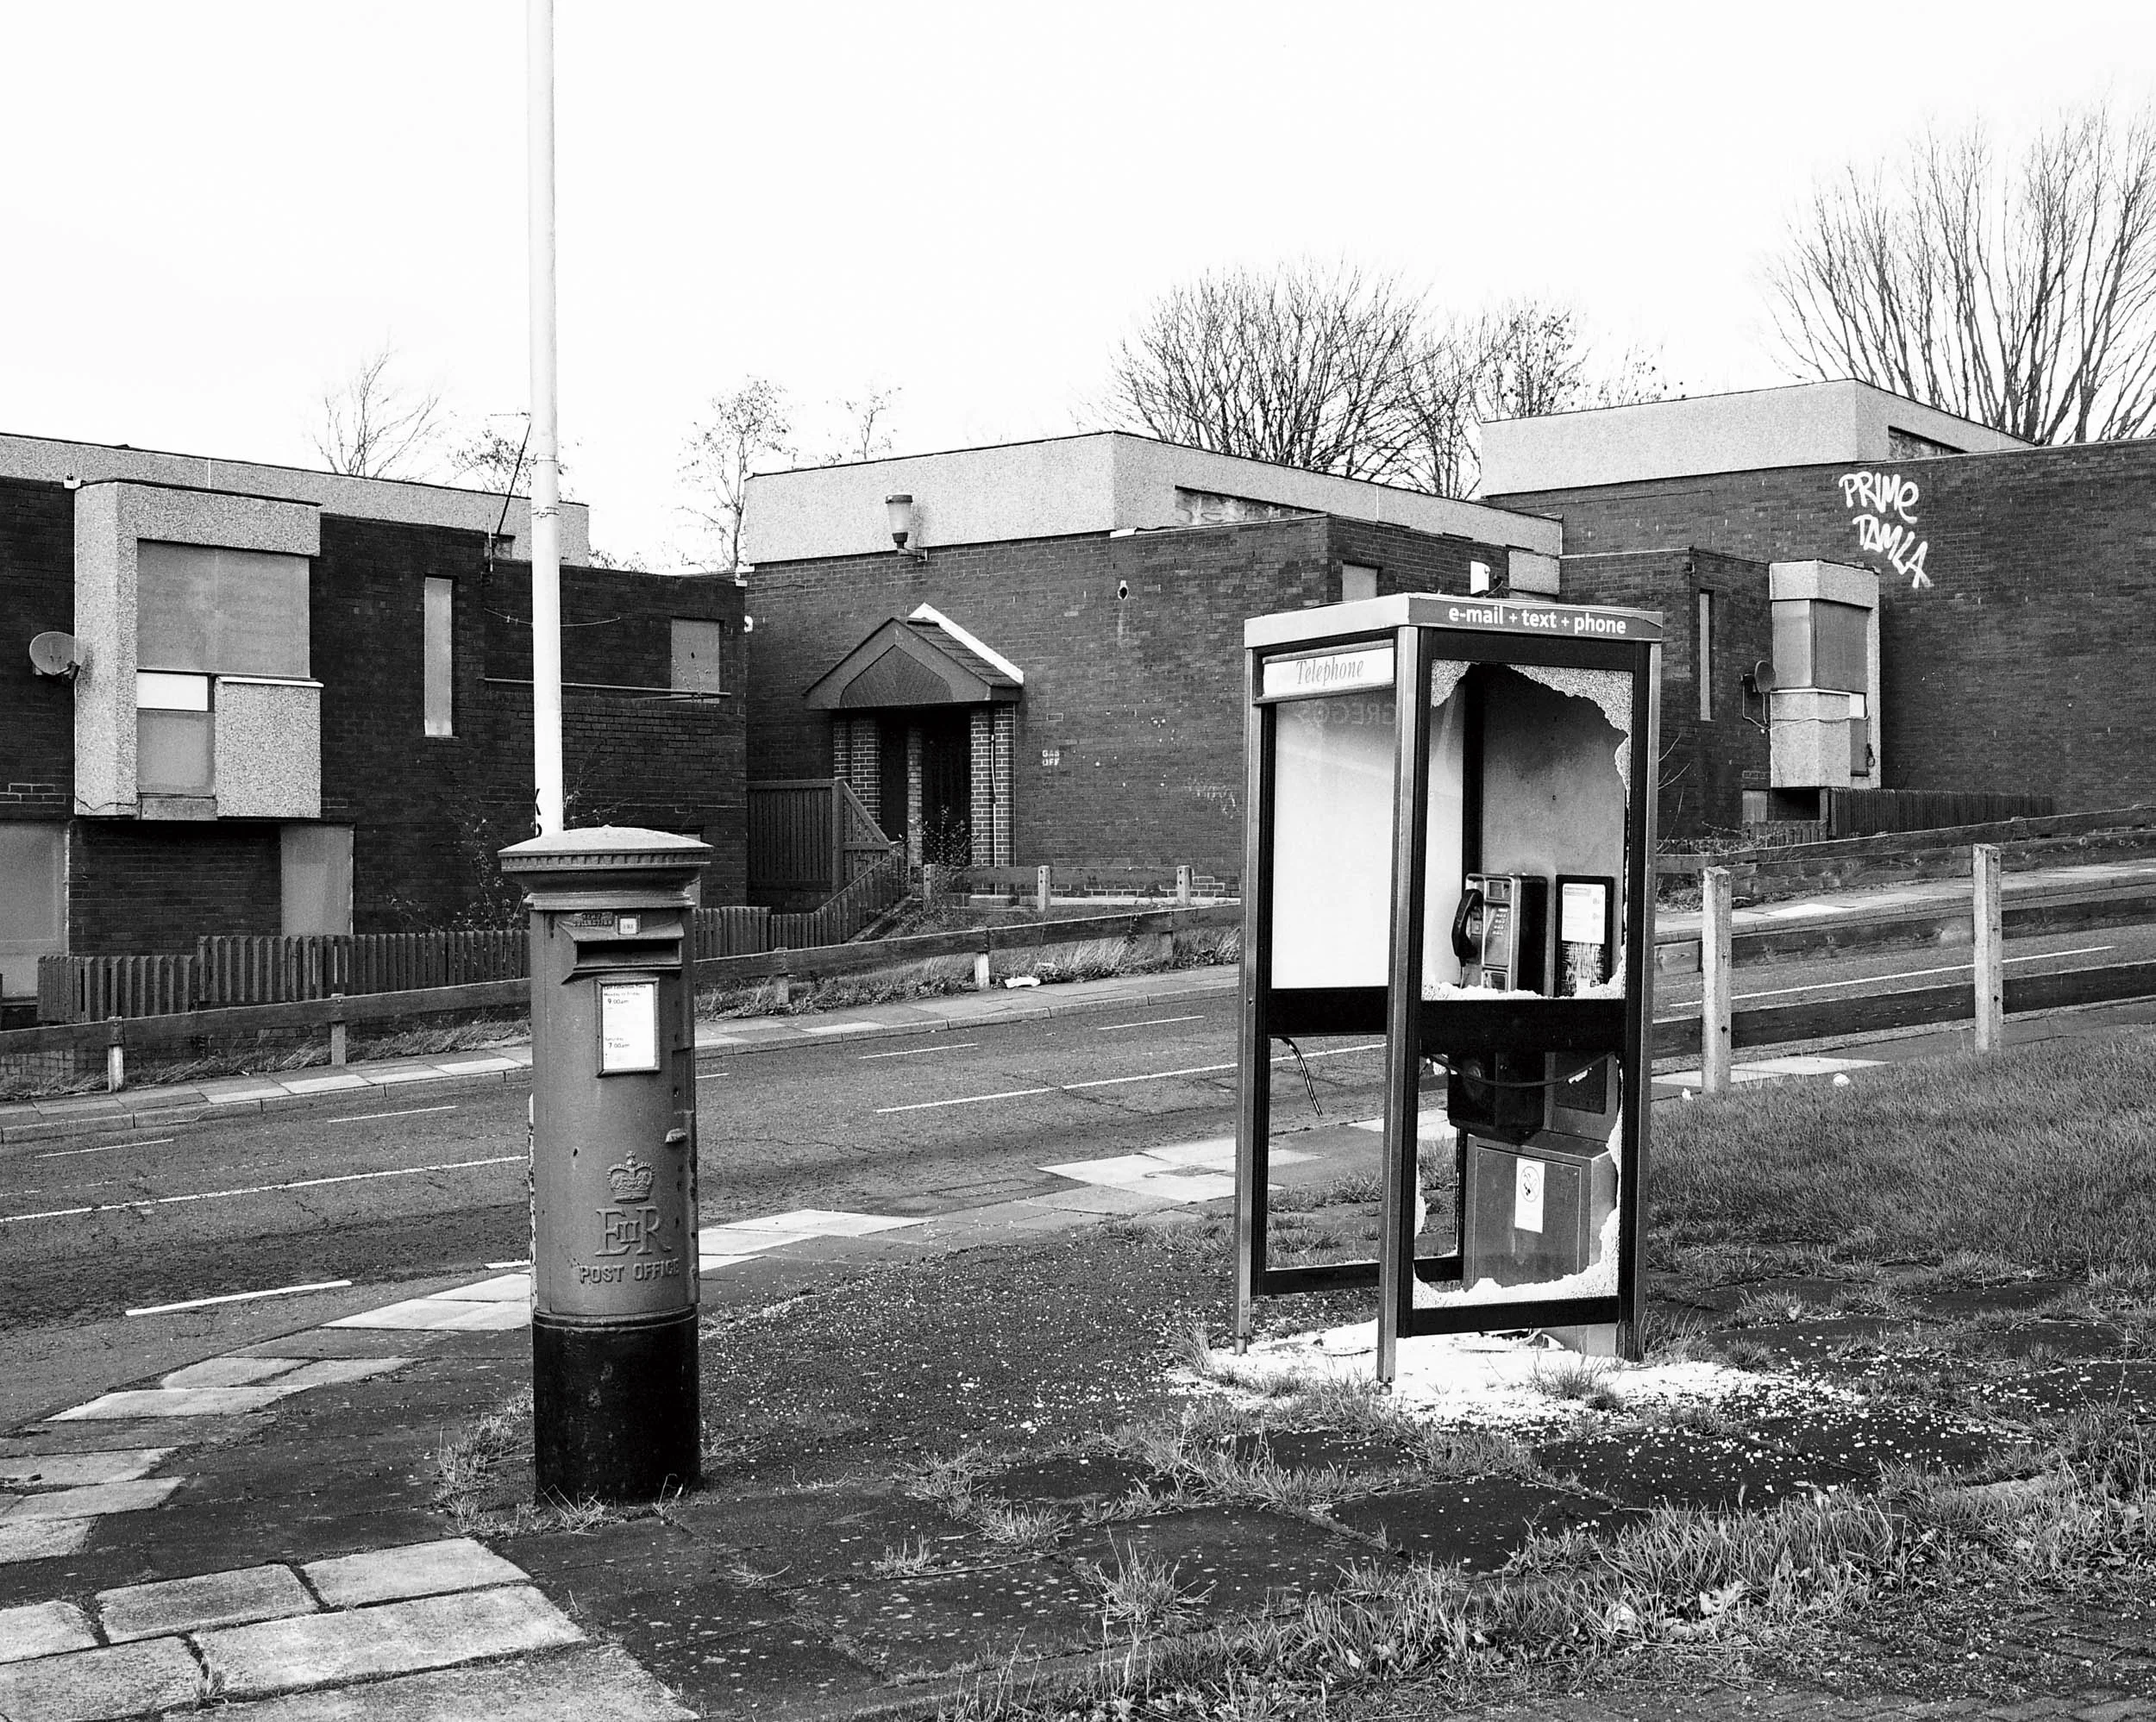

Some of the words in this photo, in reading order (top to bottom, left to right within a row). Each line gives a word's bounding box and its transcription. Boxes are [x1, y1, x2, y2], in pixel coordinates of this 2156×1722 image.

[1449, 605, 1503, 624] e-mail
[1522, 610, 1557, 629] text
[1574, 612, 1626, 635] phone
[1295, 656, 1364, 686] Telephone
[579, 1264, 624, 1284] POST
[633, 1257, 680, 1281] OFFICE
